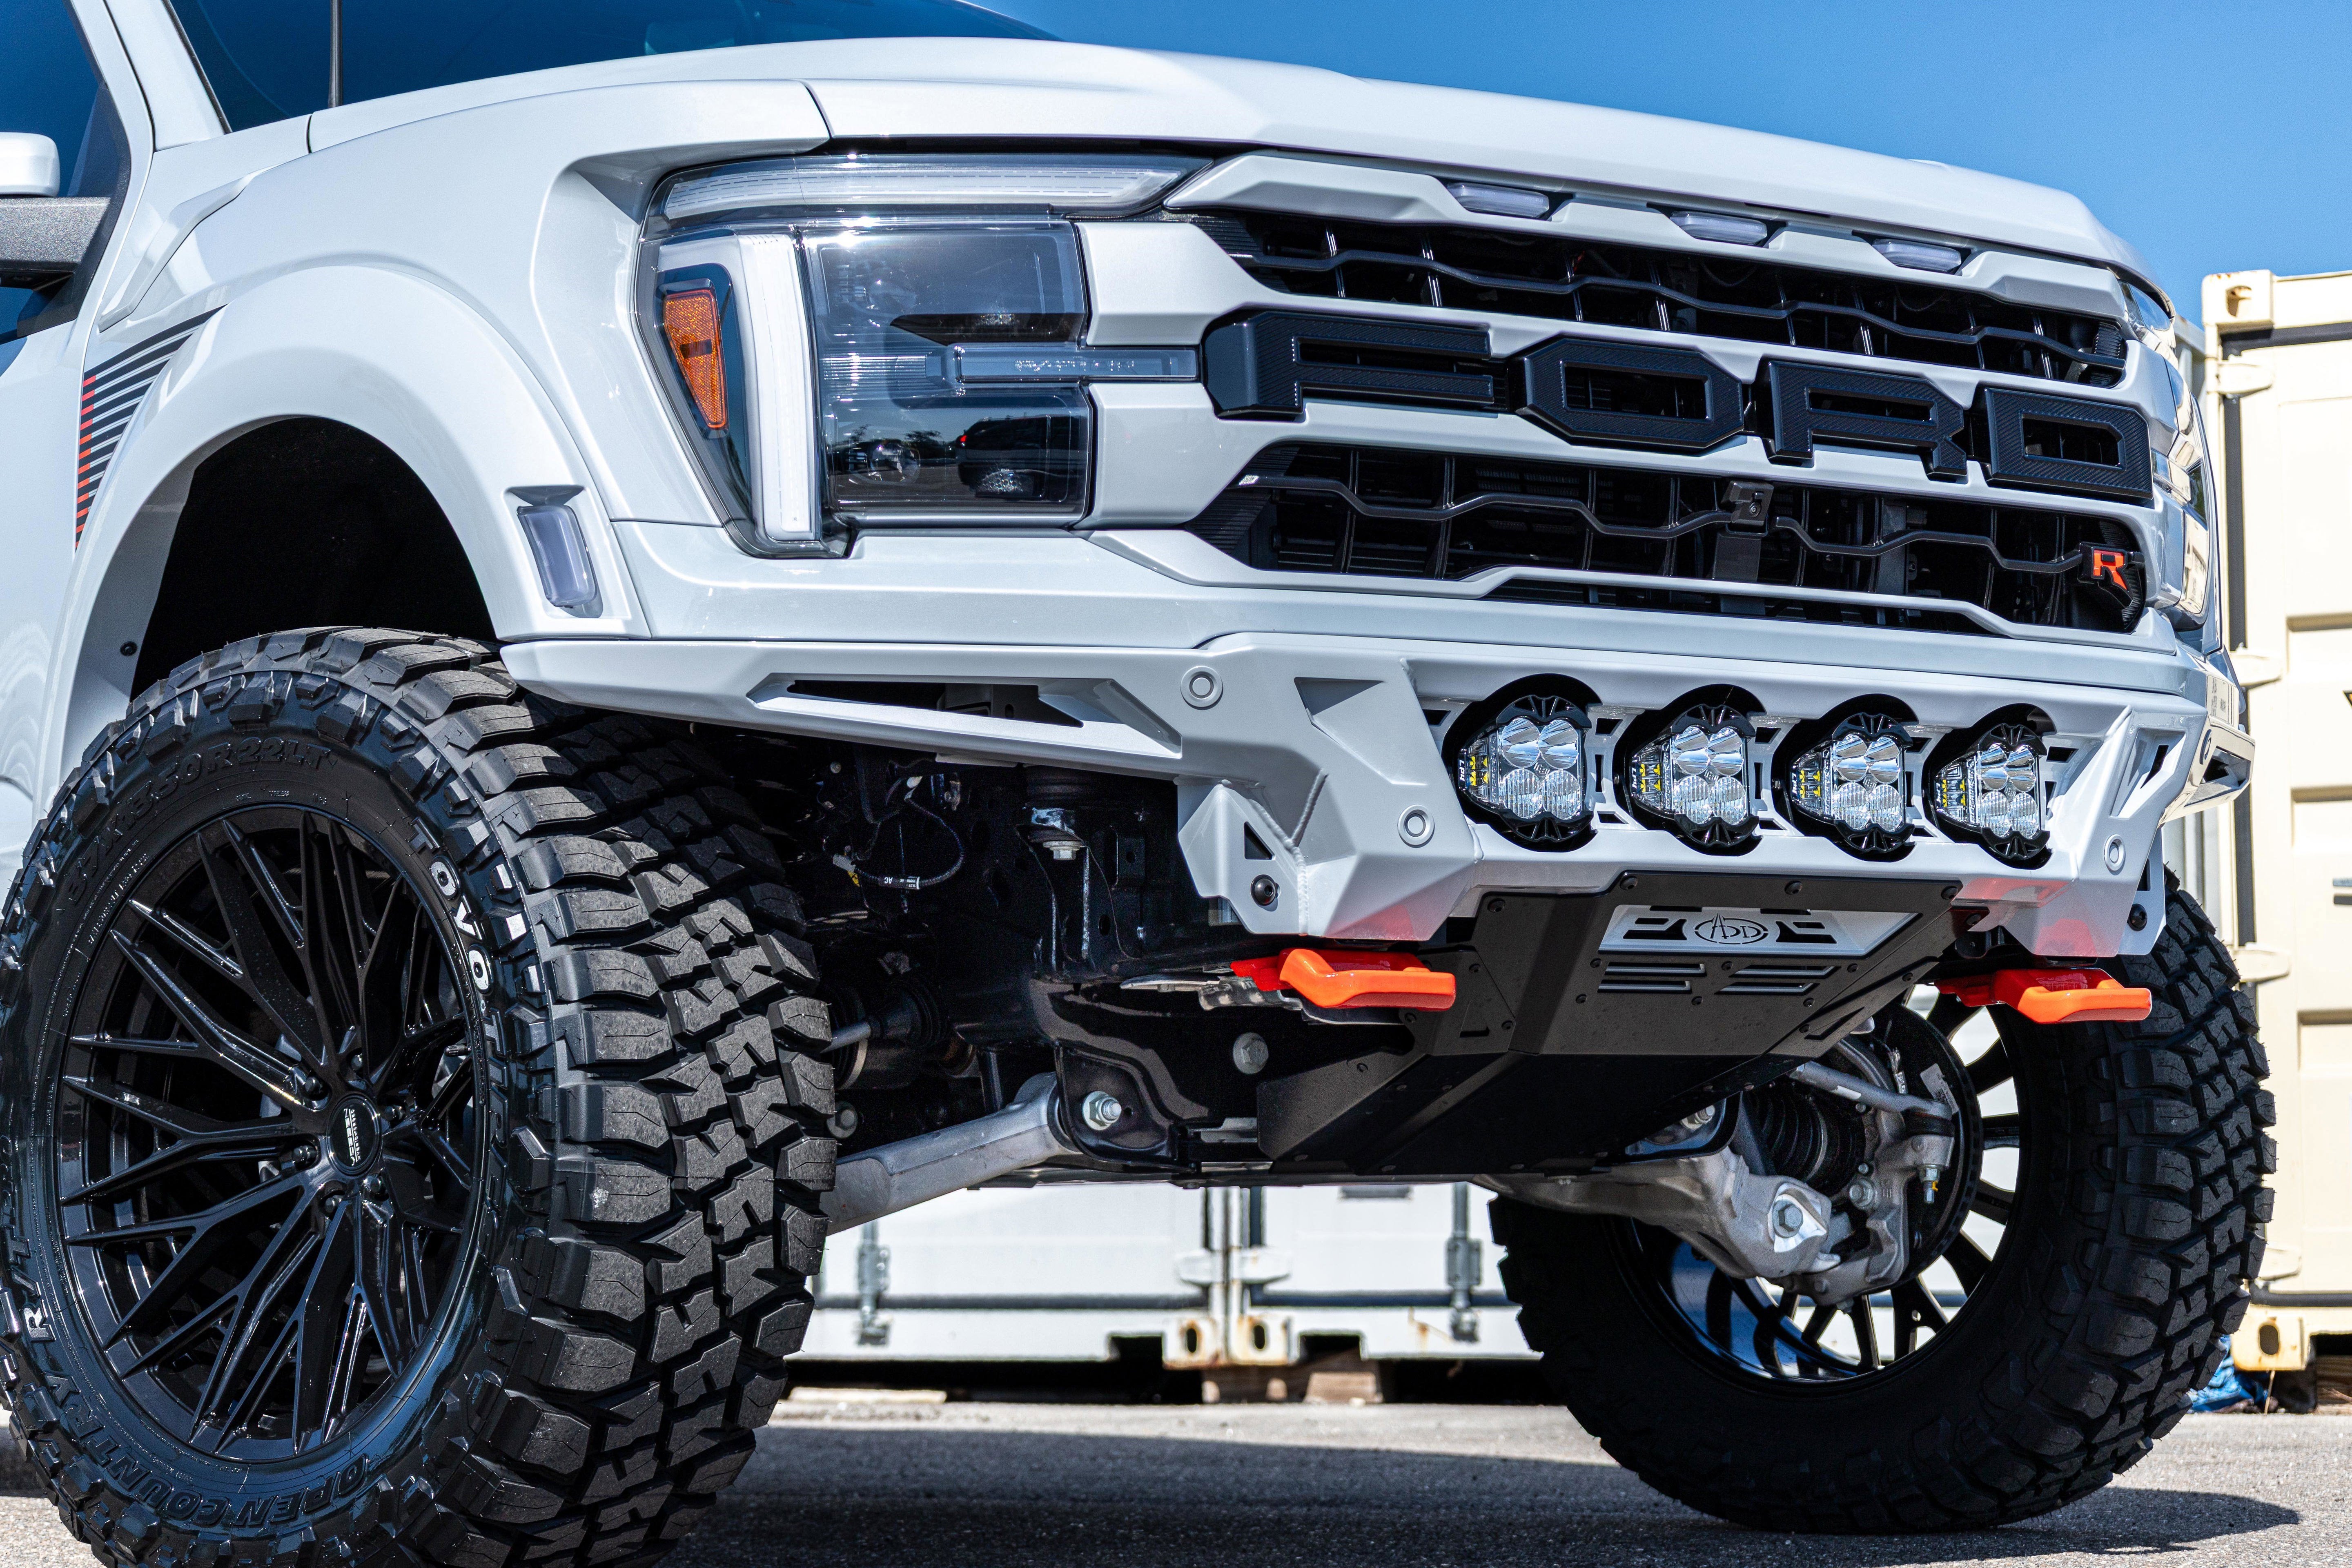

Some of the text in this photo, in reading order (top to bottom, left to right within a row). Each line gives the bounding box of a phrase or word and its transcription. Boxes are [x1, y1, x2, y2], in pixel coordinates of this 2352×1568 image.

[1202, 309, 2155, 500] FORD
[2092, 548, 2129, 591] R
[410, 816, 491, 994] TOYO
[45, 1373, 232, 1526] COUNTRY
[233, 1453, 371, 1527] OPEN
